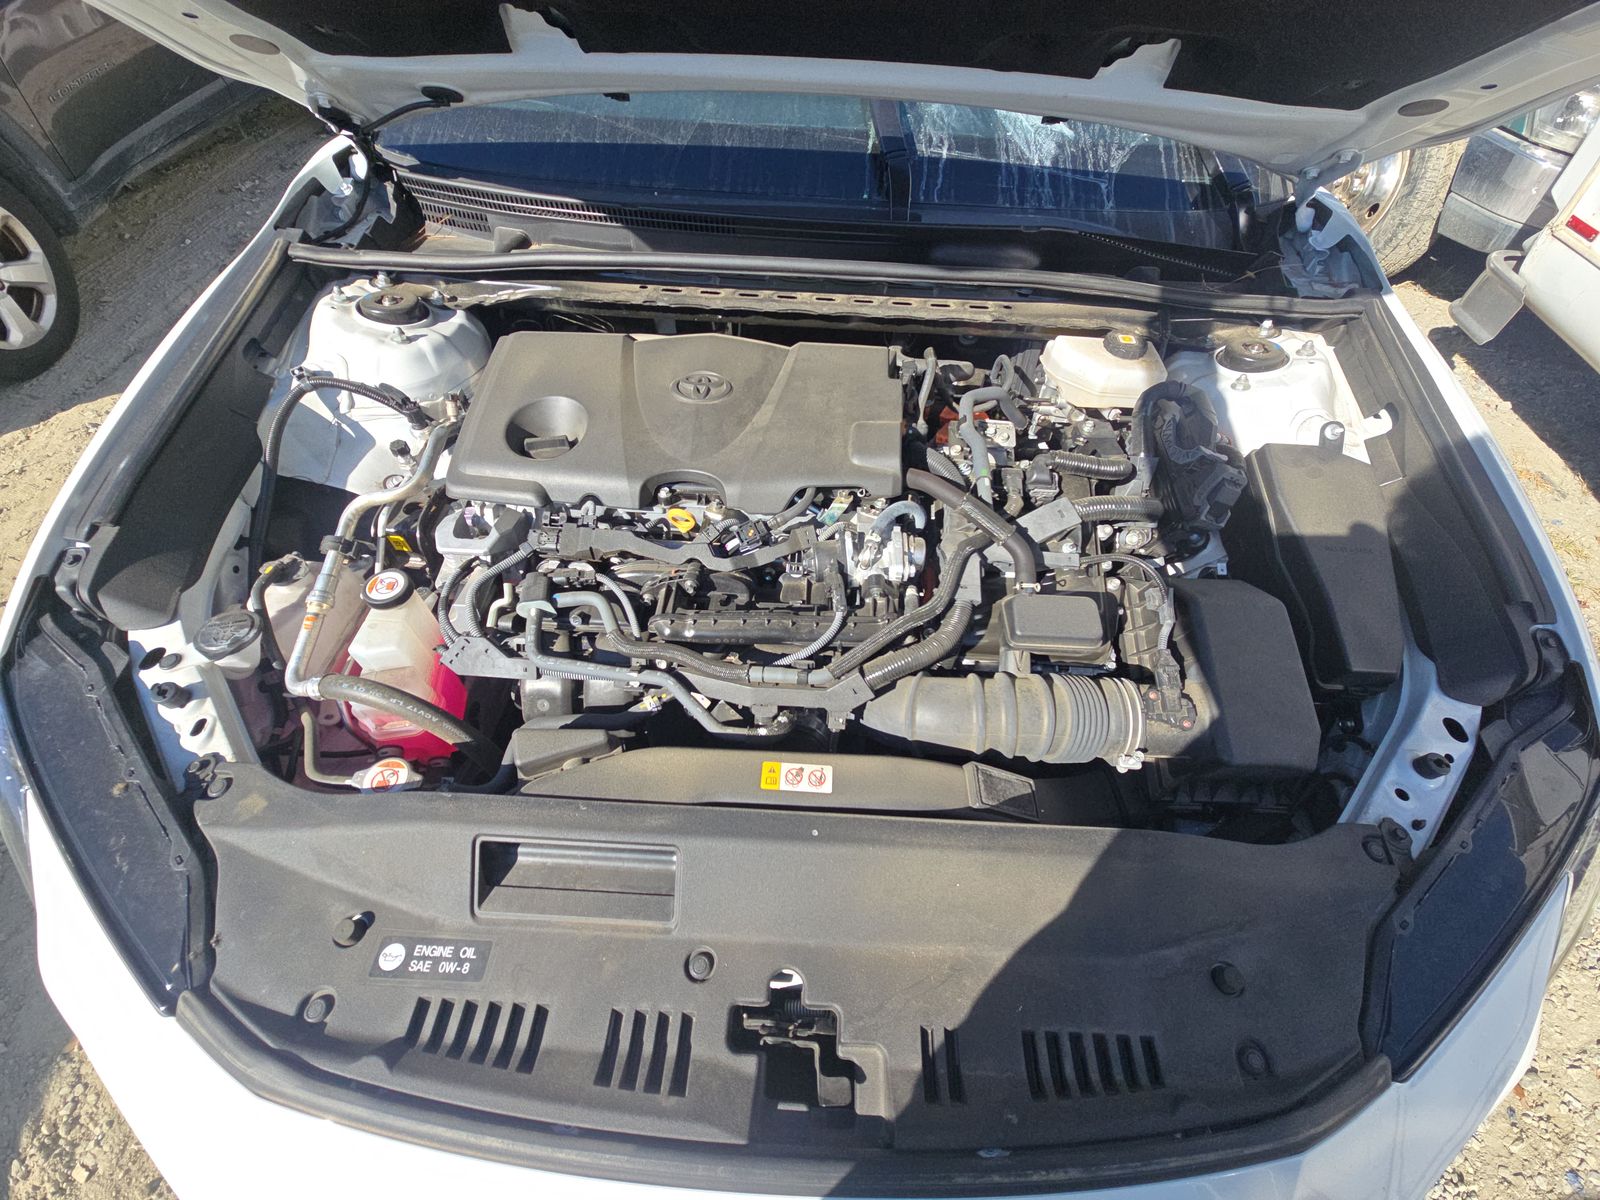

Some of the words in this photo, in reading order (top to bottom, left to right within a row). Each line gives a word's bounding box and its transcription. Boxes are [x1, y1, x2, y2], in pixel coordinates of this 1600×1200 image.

[413, 945, 455, 958] ENGINE
[459, 947, 477, 959] OIL
[408, 960, 432, 973] SAE
[438, 962, 470, 974] 0W-8
